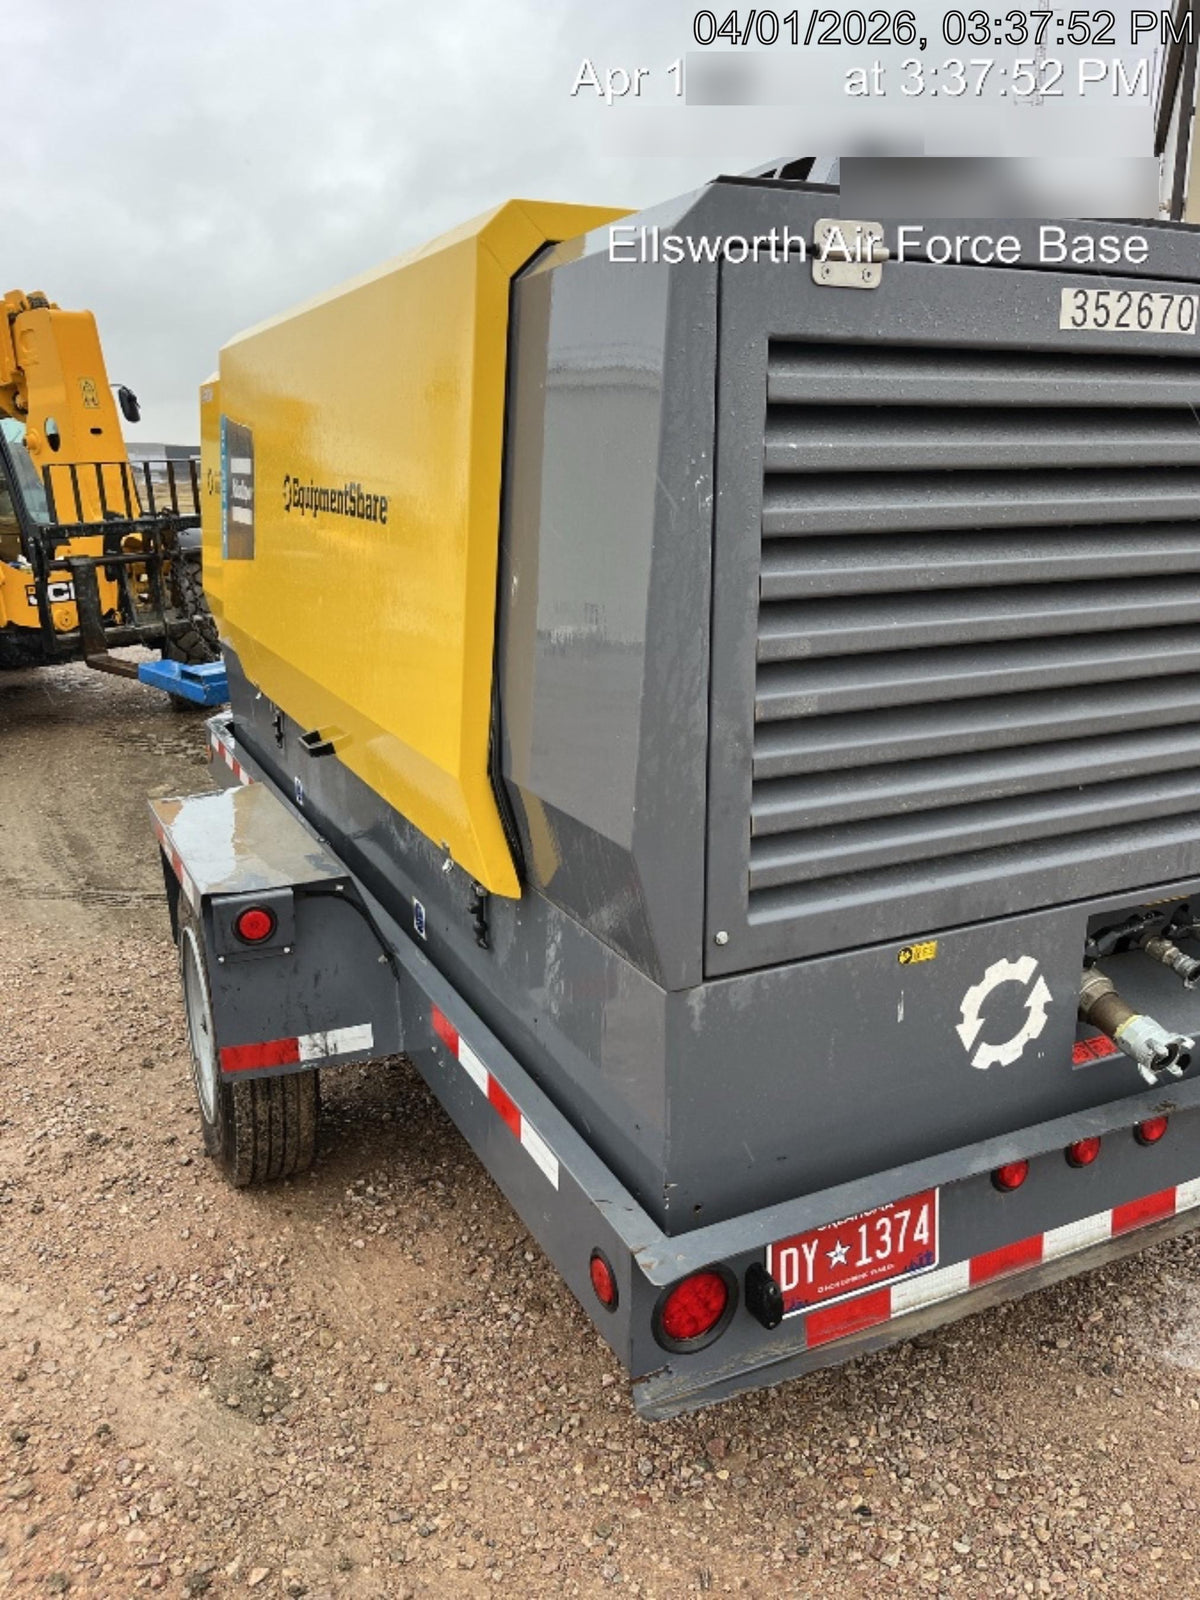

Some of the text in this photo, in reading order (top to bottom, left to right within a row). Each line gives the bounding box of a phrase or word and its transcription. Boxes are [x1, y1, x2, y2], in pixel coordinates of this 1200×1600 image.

[1070, 289, 1194, 331] 352670
[292, 477, 388, 525] EquipmentShare
[779, 1239, 819, 1292] DY
[855, 1203, 931, 1268] 1374
